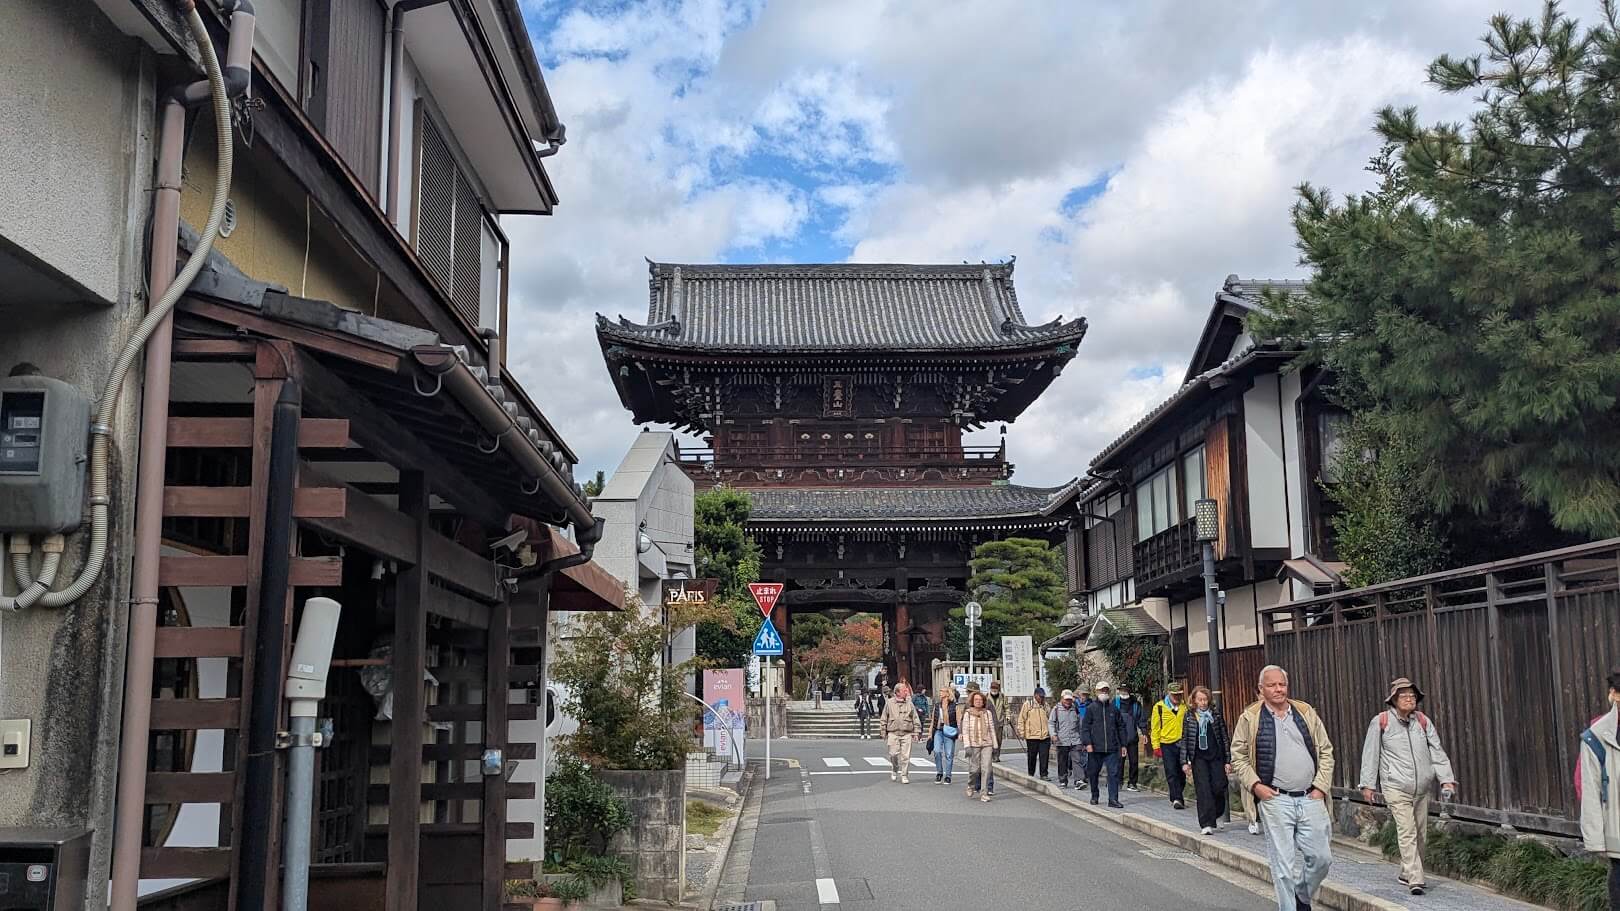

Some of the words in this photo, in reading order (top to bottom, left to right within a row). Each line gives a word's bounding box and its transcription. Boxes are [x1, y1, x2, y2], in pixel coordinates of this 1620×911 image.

[670, 580, 704, 602] PARIS
[756, 587, 777, 595] 止まれ
